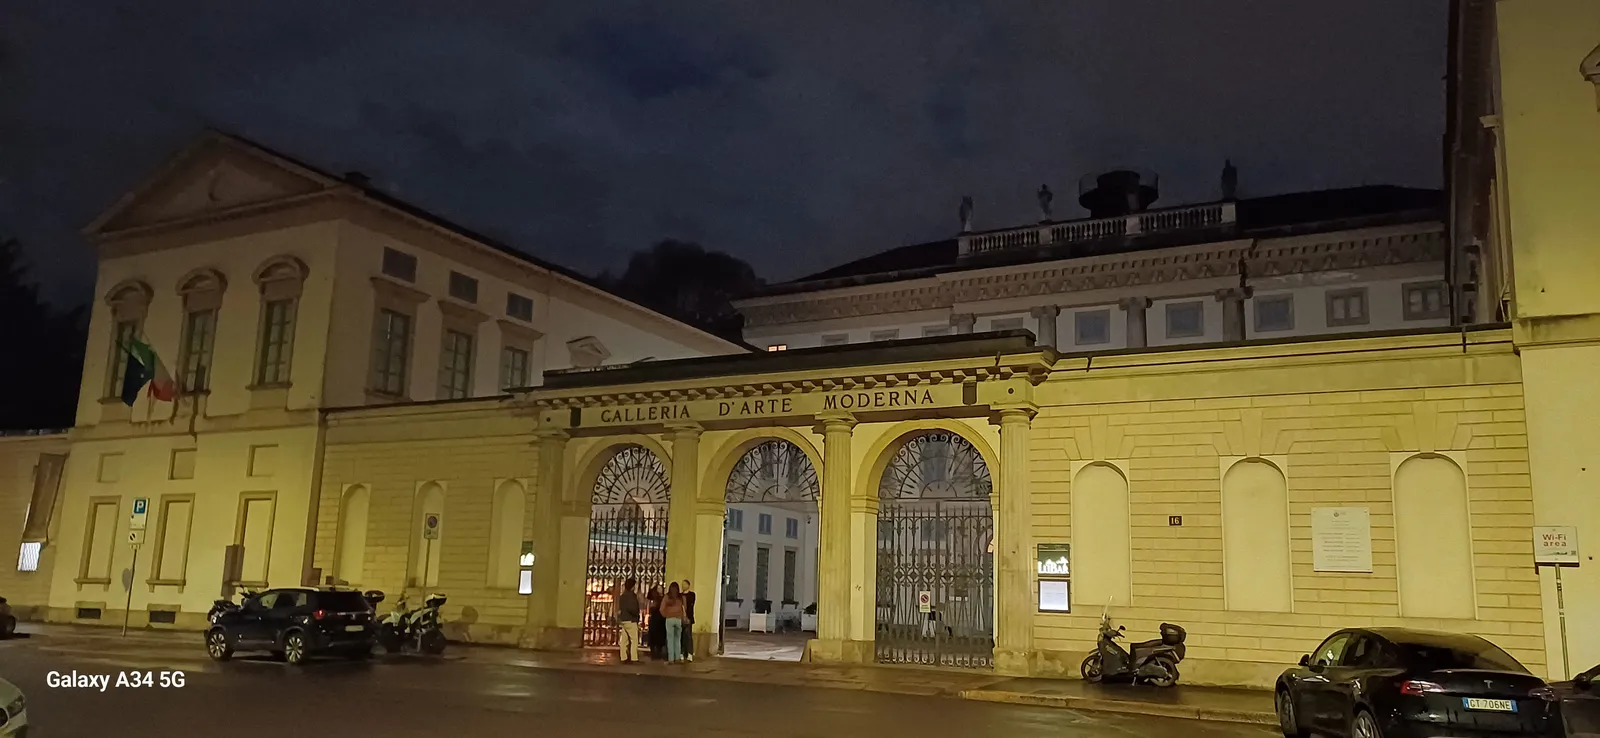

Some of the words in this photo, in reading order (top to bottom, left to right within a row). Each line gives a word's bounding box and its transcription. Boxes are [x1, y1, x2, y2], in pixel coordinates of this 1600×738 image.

[600, 404, 691, 423] GALLERIA
[718, 397, 793, 417] D'ARTE
[823, 389, 934, 410] MODERNA
[136, 500, 144, 512] P
[1171, 516, 1180, 525] 16
[1542, 533, 1567, 541] Wi-Fi
[1483, 699, 1512, 710] 706NE
